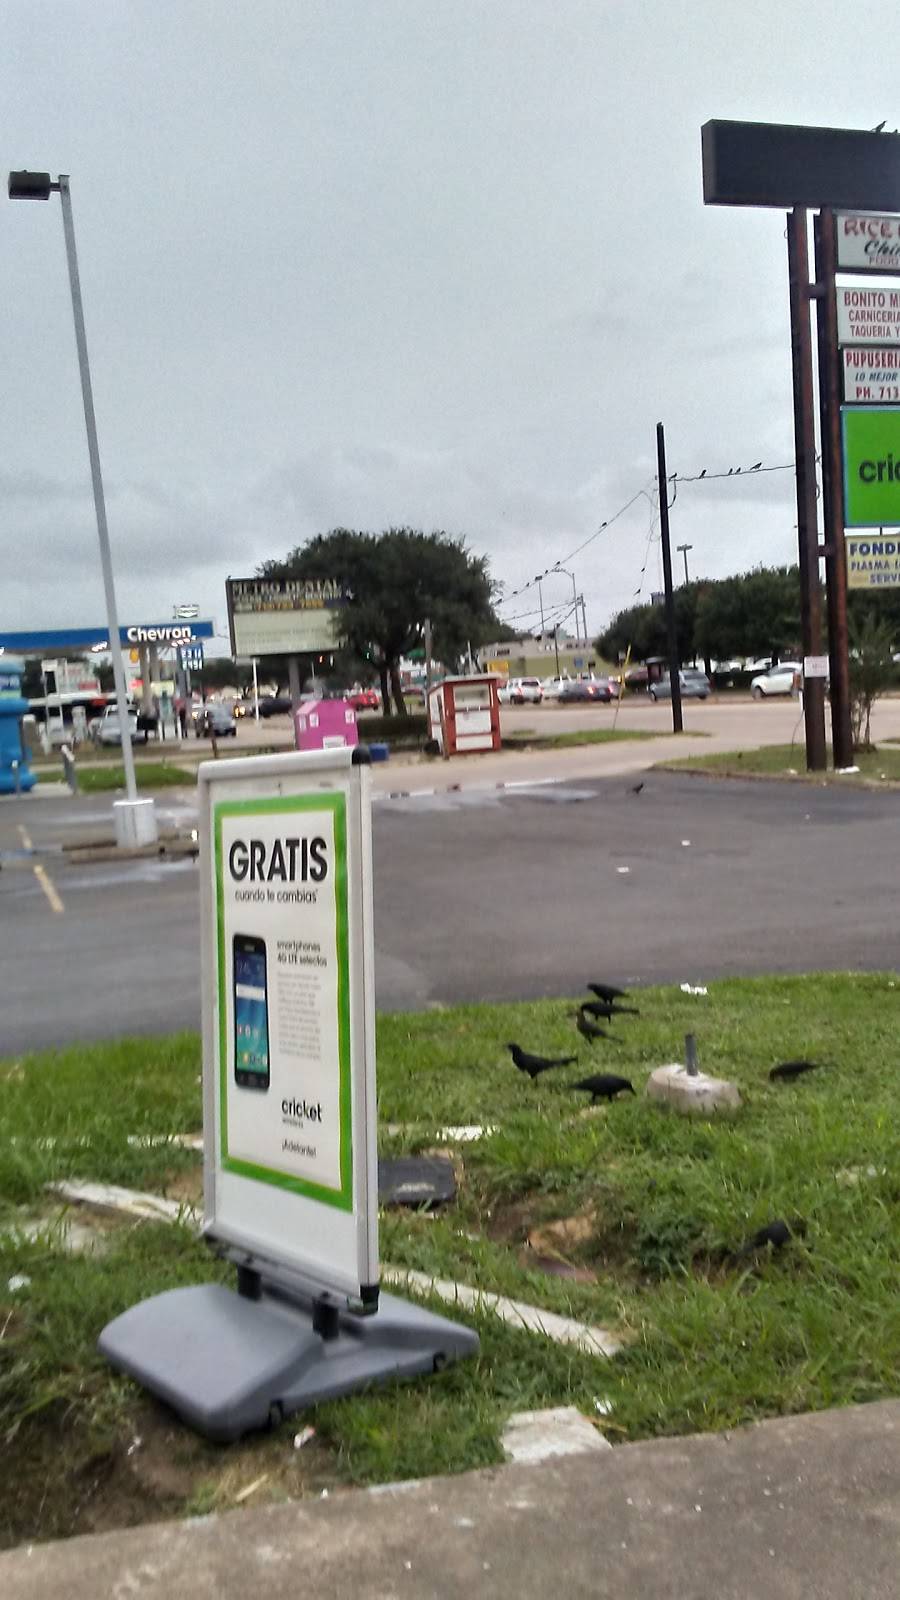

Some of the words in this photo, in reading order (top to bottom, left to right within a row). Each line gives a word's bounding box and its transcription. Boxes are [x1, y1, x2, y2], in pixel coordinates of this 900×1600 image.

[844, 291, 885, 307] BONITO
[890, 293, 900, 308] M
[850, 325, 891, 337] TAQUERIA
[846, 351, 900, 369] PUPUSERI
[869, 372, 898, 382] MEJOR
[880, 387, 899, 400] 713
[850, 542, 900, 556] FOND
[851, 560, 890, 571] PLASMA
[127, 626, 191, 642] Chevron
[229, 837, 328, 883] GRATIS
[235, 889, 265, 901] cuando
[288, 953, 298, 964] LTE
[281, 1098, 322, 1123] cricket
